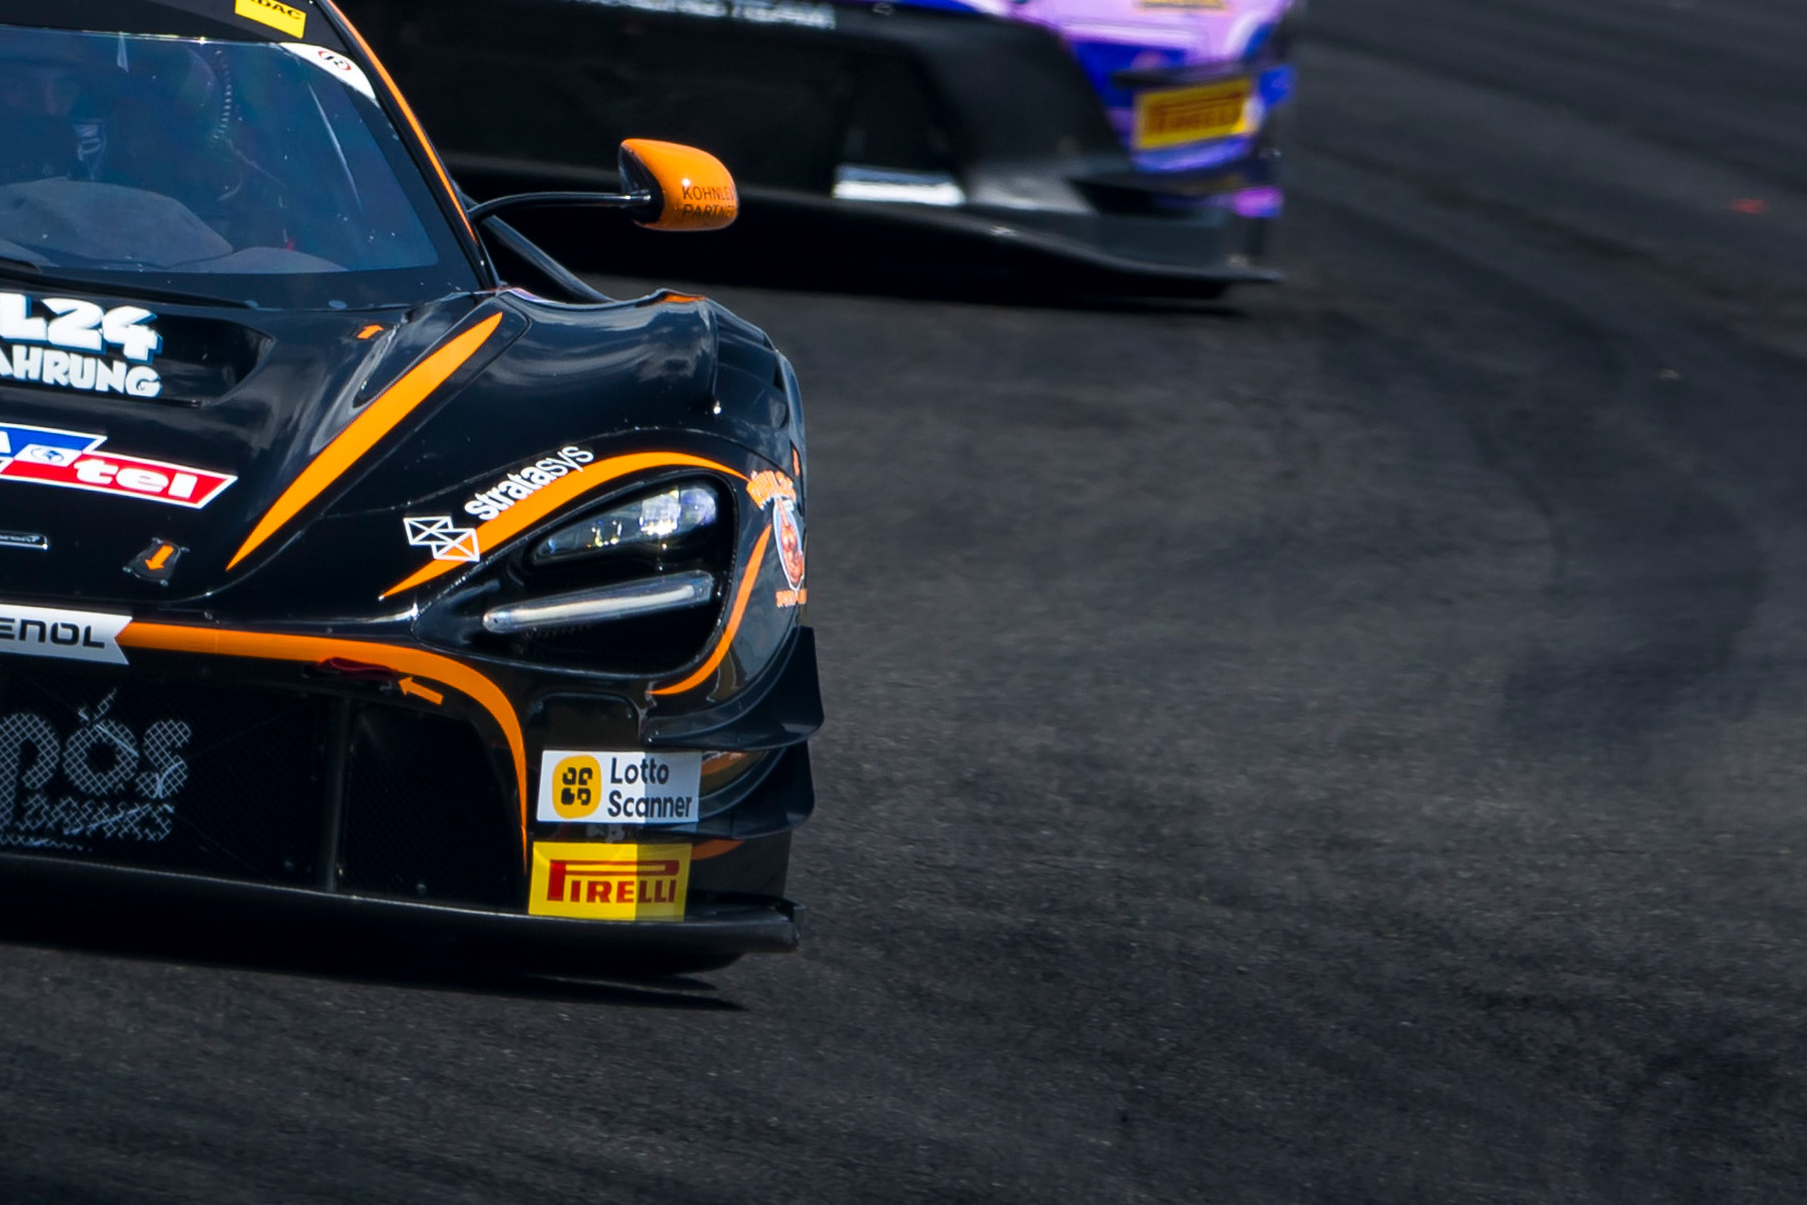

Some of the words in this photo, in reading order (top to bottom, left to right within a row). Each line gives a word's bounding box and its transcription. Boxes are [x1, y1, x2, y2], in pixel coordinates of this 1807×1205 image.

[73, 456, 199, 500] tel
[463, 444, 596, 522] stratasys
[610, 756, 670, 786] Lotto
[606, 788, 693, 819] Scanner
[546, 858, 681, 904] PIRELLI
